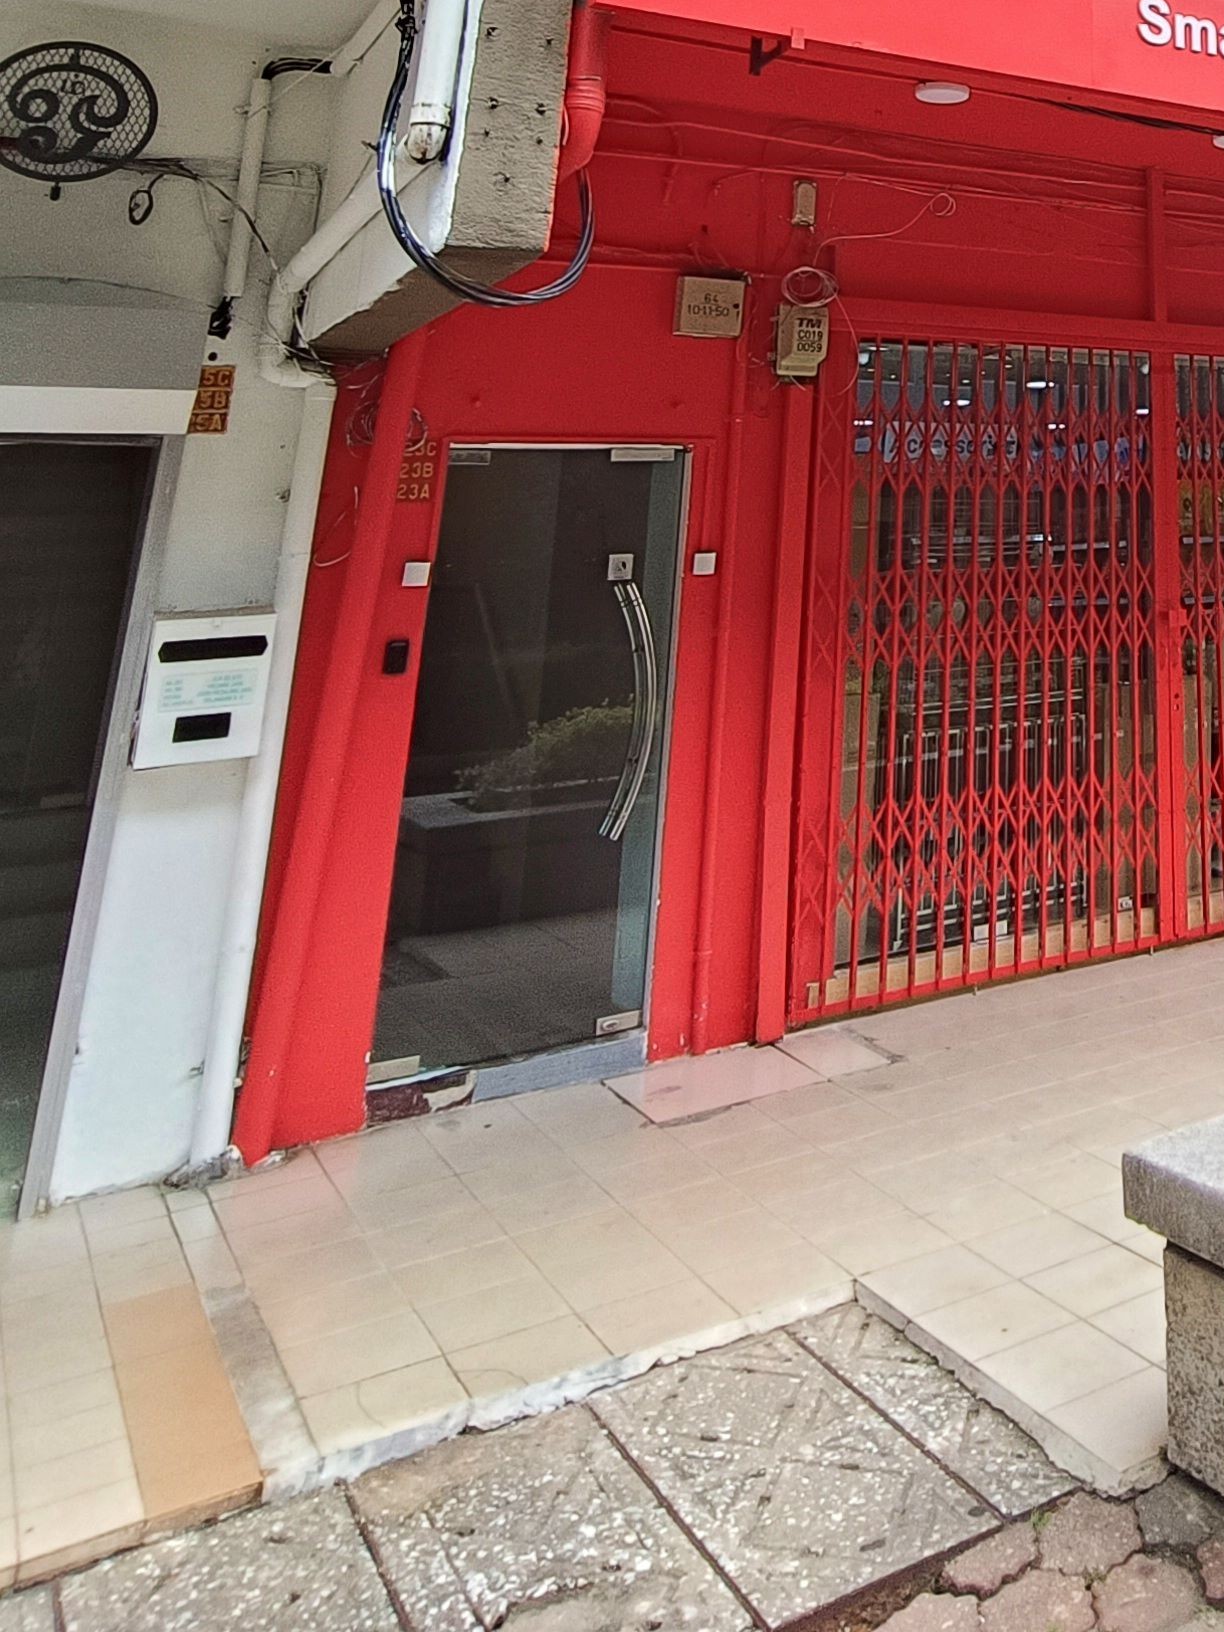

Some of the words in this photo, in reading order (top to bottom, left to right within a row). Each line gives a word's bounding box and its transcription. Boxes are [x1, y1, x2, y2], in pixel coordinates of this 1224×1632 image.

[796, 317, 822, 329] TM
[797, 330, 824, 342] C019
[202, 370, 231, 386] 5C
[200, 392, 228, 408] 5B
[193, 414, 223, 431] 5A
[400, 462, 434, 478] 23B
[396, 484, 431, 500] 23A
